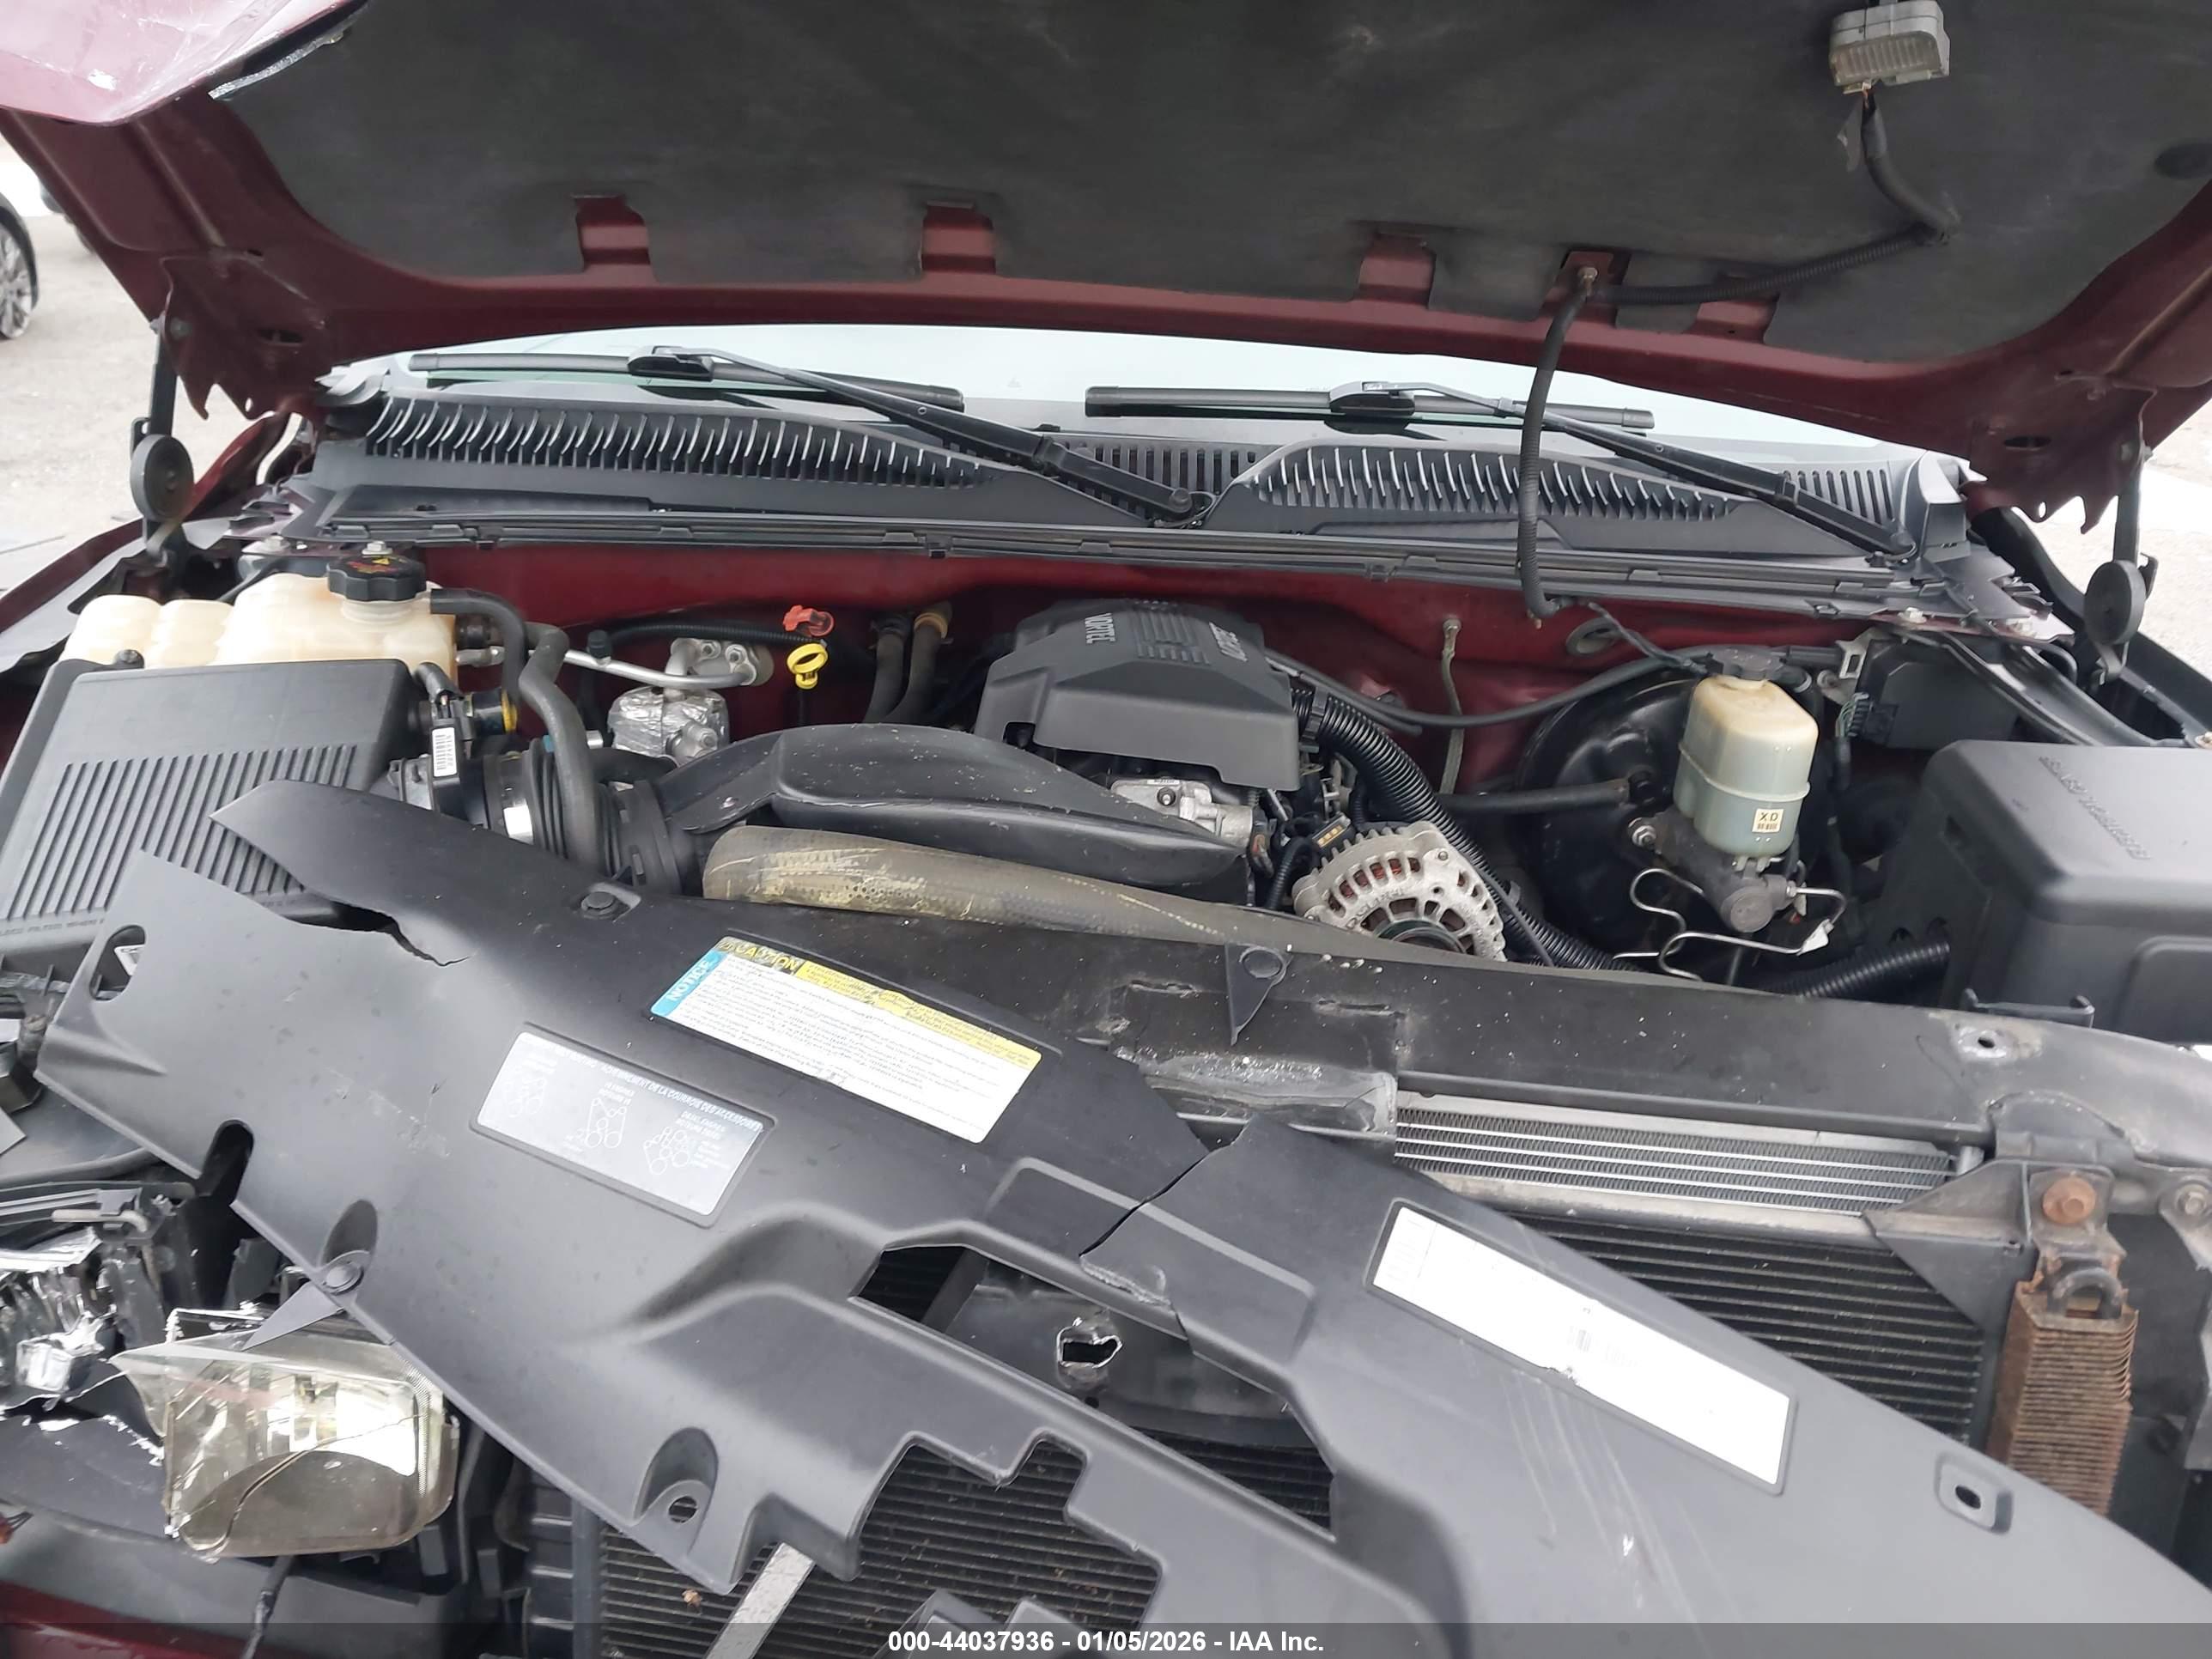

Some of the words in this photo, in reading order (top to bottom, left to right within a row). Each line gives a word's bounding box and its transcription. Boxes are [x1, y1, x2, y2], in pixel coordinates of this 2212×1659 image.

[1085, 612, 1116, 644] VORTEC
[734, 944, 799, 972] CAUTION
[666, 959, 713, 1001] NOTICE
